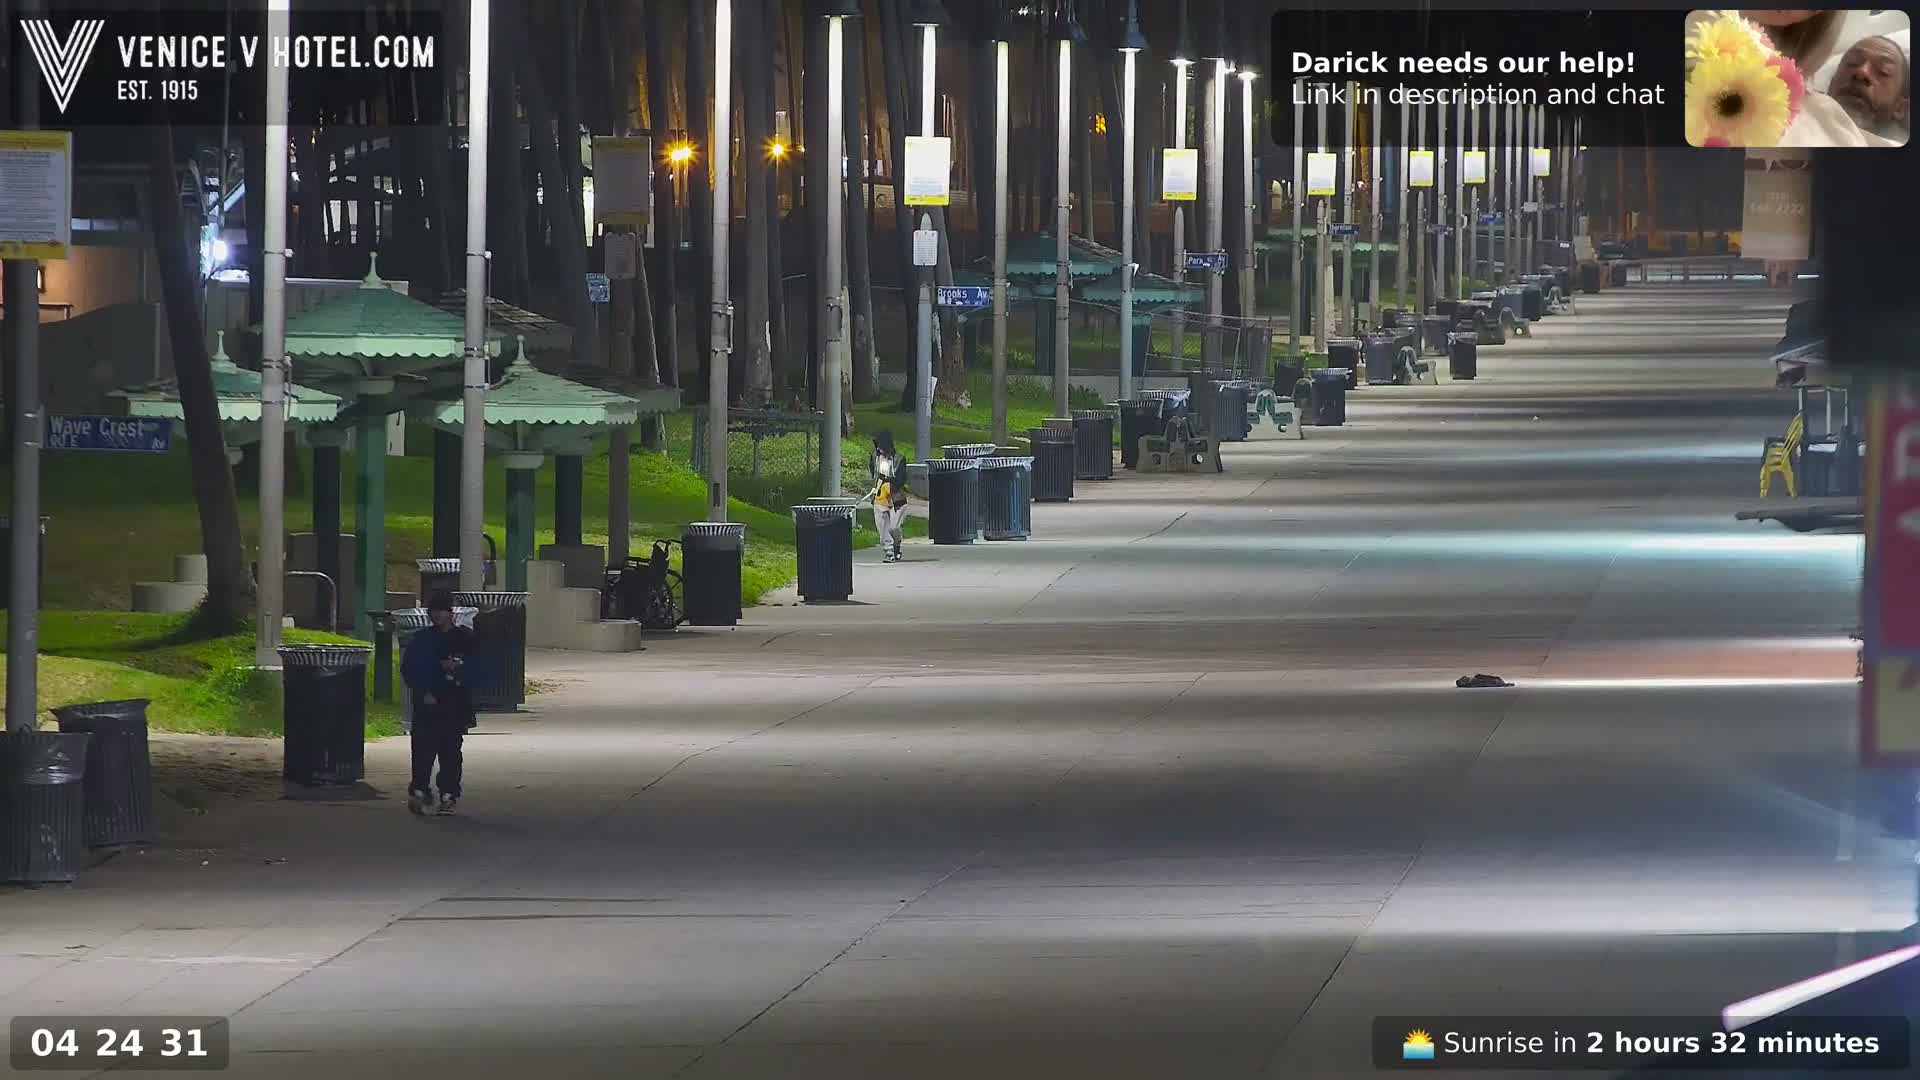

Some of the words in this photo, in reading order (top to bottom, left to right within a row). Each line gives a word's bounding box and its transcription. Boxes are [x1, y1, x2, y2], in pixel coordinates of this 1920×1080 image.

[937, 288, 968, 299] Brooks
[50, 415, 92, 435] Wave
[99, 416, 144, 437] Crest
